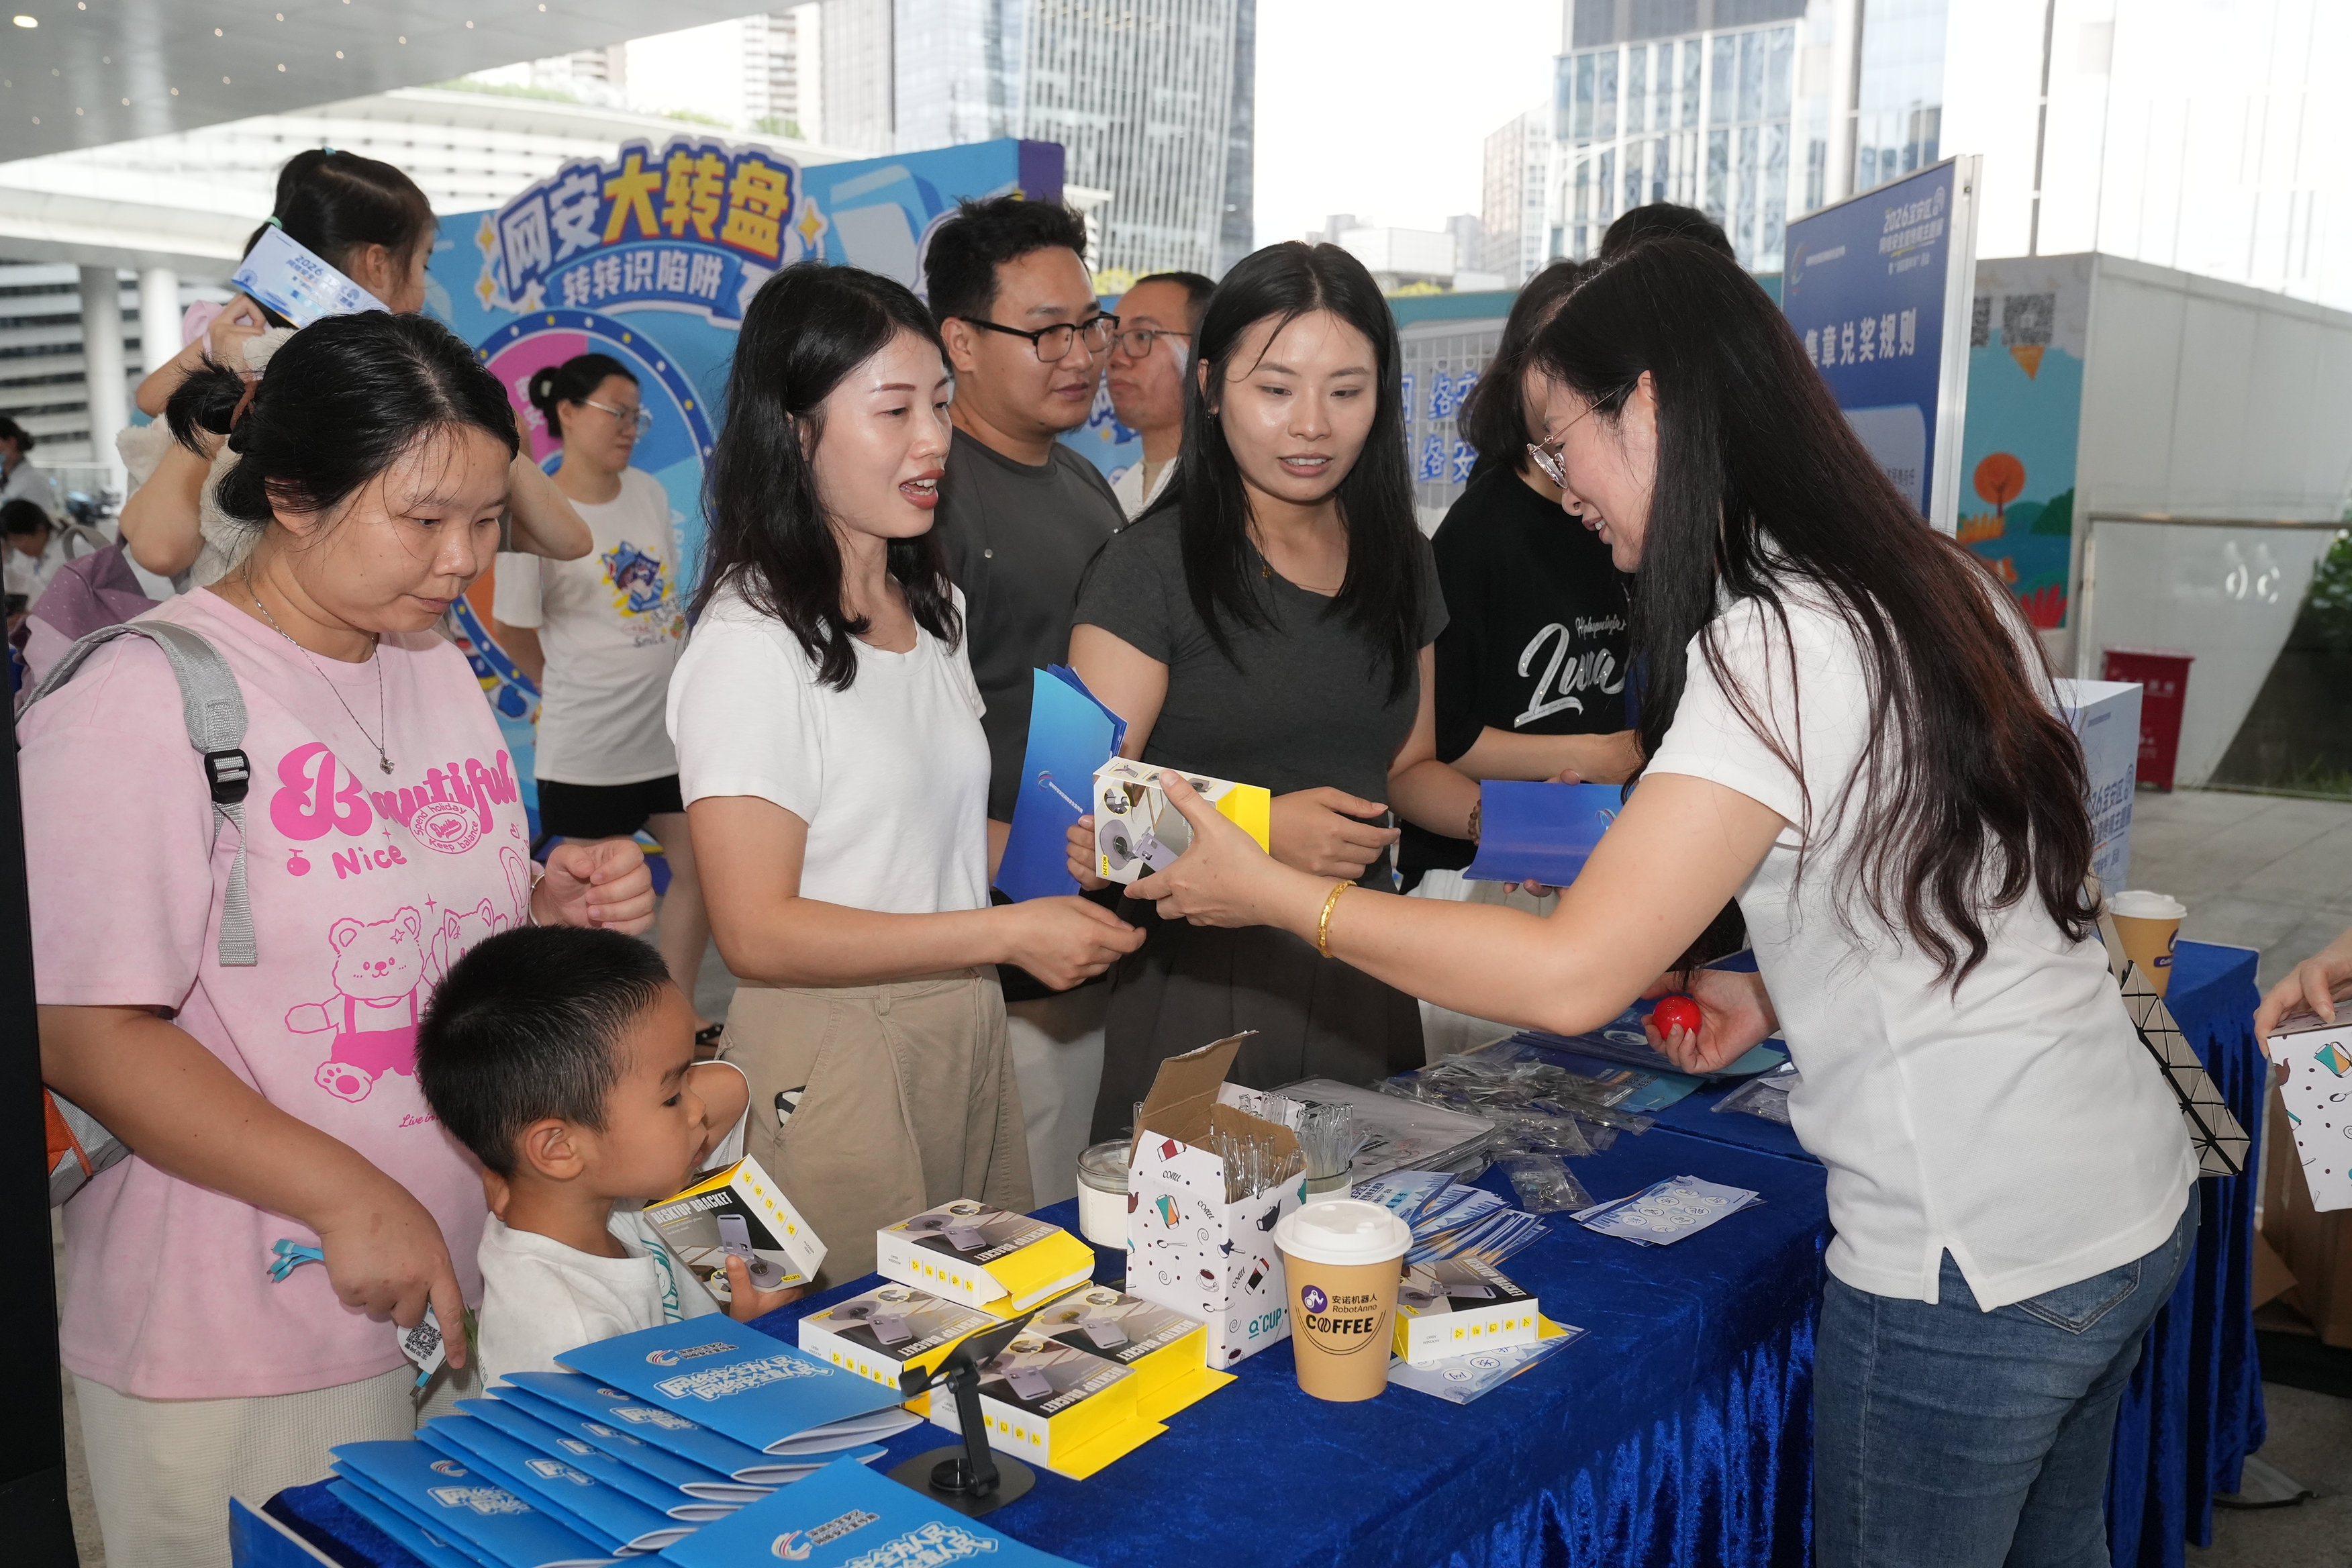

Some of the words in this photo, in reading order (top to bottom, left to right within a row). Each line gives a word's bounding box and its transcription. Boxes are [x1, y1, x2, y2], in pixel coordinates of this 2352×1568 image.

[502, 150, 789, 290] 网安大转盘
[563, 249, 724, 307] 转转识陷阱
[1805, 307, 1916, 369] 集章兑奖规则
[413, 810, 428, 836] Spend
[428, 803, 467, 814] holiday
[429, 838, 454, 852] Keep
[457, 821, 478, 849] balance
[332, 845, 407, 879] Nice
[399, 1114, 424, 1128] Live
[650, 1202, 691, 1224] DESKTOP
[689, 1191, 733, 1212] BRACKET
[1012, 1226, 1055, 1246] DESKTOP
[974, 1242, 1014, 1262] BRACKET
[1463, 1257, 1494, 1283] DESKTOP
[1489, 1276, 1526, 1297] BRACKET
[1332, 1293, 1377, 1304] 安诺机器人
[1332, 1304, 1377, 1313] RobotAnno
[940, 1315, 985, 1338] DESKTOP
[1156, 1319, 1197, 1343] DESKTOP
[897, 1334, 945, 1357] BRACKET
[1116, 1340, 1159, 1361] BRACKET
[1082, 1367, 1128, 1392] DESKTOP
[1039, 1387, 1085, 1414] BRACKET
